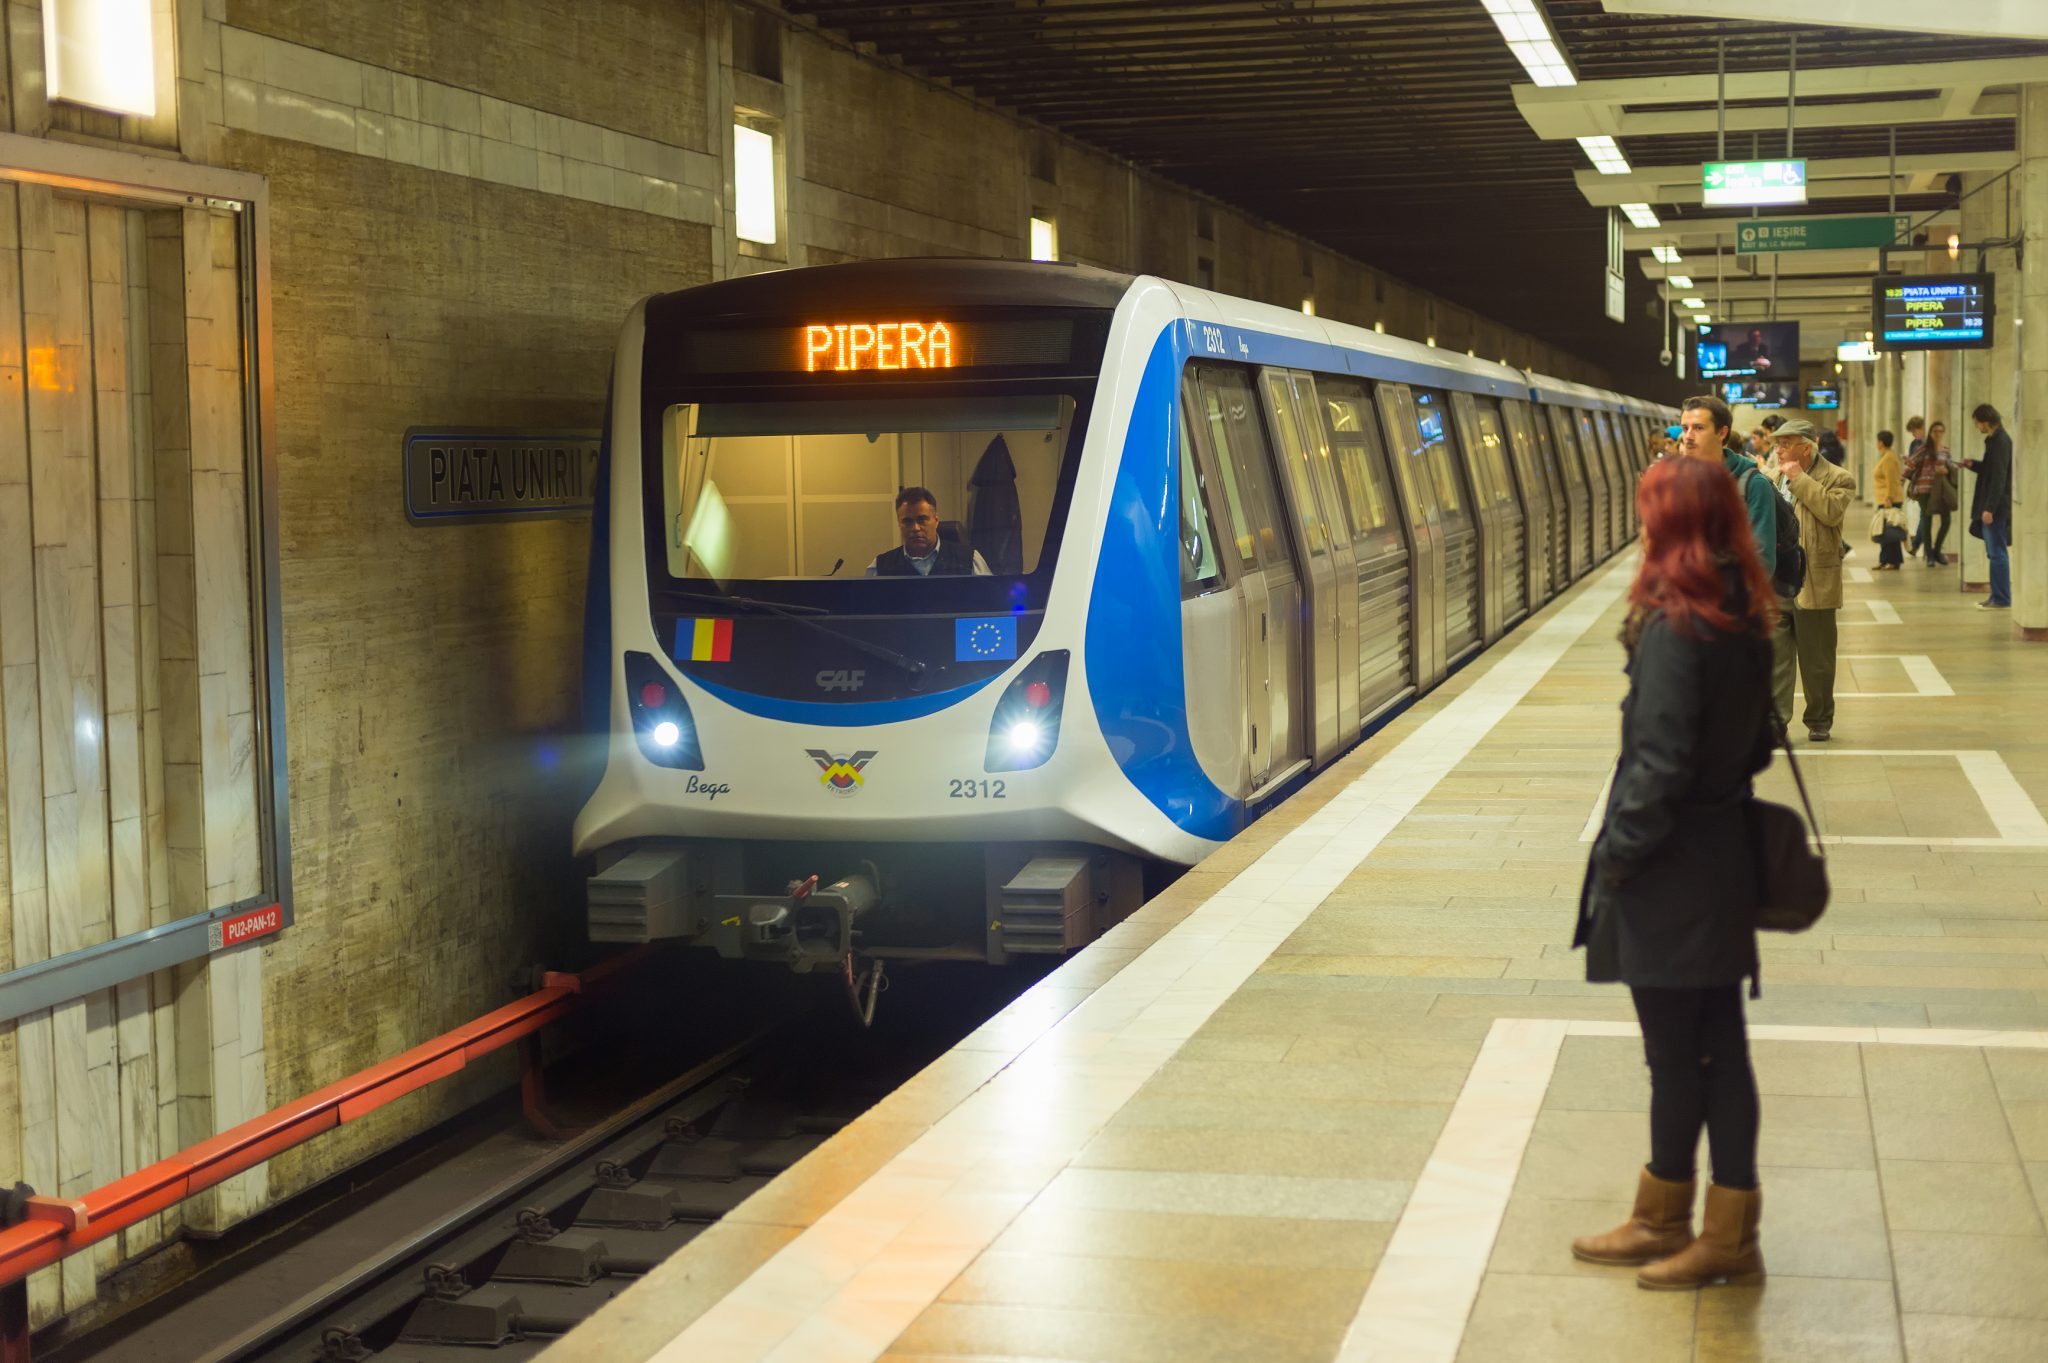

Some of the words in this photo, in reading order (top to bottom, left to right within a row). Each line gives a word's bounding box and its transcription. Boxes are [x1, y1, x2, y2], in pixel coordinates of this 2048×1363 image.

[1903, 287, 1929, 297] PIATA
[1931, 286, 1957, 296] UNIRII
[1959, 285, 1966, 295] 2
[1906, 301, 1944, 312] PIPERA
[1906, 318, 1944, 329] PIPERA
[806, 322, 951, 372] PIPERA
[1203, 326, 1226, 354] 2312
[428, 447, 505, 505] PIATA
[511, 446, 583, 501] UNIRII
[816, 670, 865, 692] CAF
[685, 775, 731, 801] Bega
[949, 779, 1006, 799] 2312
[228, 911, 276, 940] PU2-PAN-12
